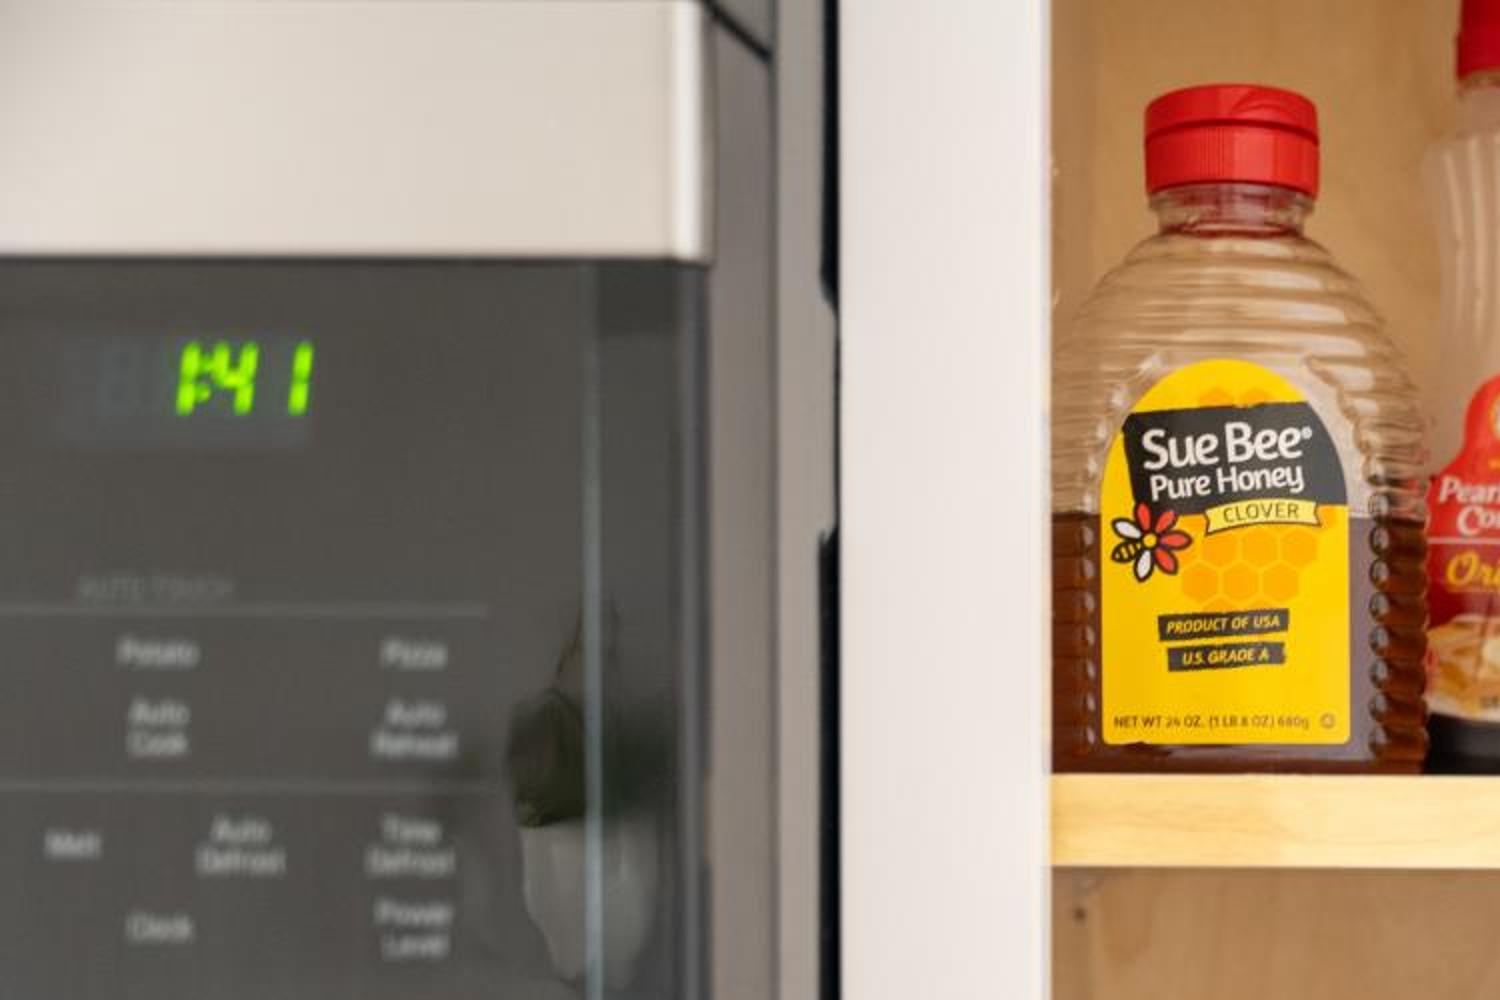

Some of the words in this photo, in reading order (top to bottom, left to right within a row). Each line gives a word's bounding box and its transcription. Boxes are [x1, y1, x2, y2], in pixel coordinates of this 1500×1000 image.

[174, 340, 313, 415] 1:41
[1142, 428, 1219, 470] Sue
[1150, 473, 1211, 502] Pure
[1216, 464, 1305, 494] Honey
[1222, 501, 1299, 524] CLOVER
[1167, 617, 1227, 634] PRODUCT
[1231, 616, 1249, 629] OF
[1253, 615, 1280, 627] USA
[1208, 650, 1254, 664] GRADE
[1259, 648, 1270, 661] A
[1114, 715, 1138, 729] NET
[1142, 715, 1162, 729] WT
[1222, 715, 1238, 729] LB
